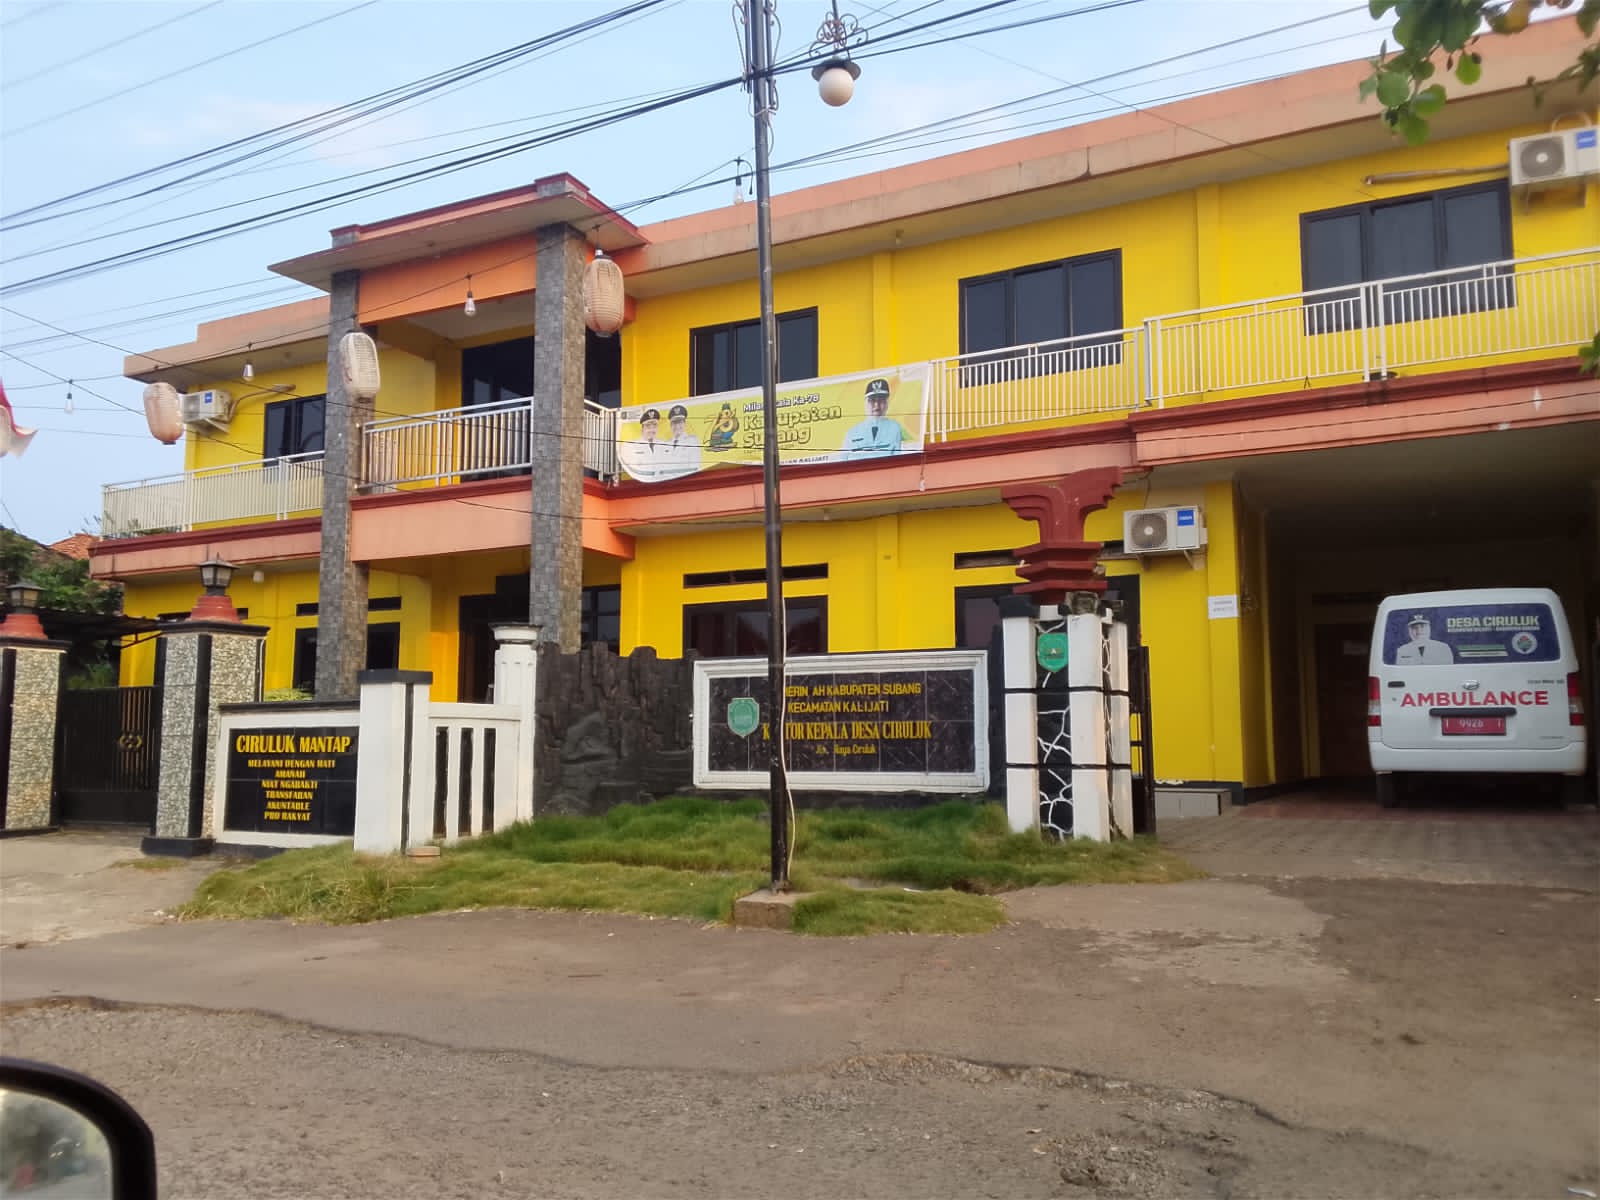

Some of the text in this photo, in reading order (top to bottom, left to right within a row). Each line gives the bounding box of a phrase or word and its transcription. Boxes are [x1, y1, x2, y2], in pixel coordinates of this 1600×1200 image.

[743, 405, 842, 432] Kaupaten
[743, 426, 811, 449] Suang
[1447, 614, 1540, 628] DESA CIRULUK
[826, 683, 880, 696] KABUPATEN
[882, 682, 922, 695] SUBANG
[1400, 690, 1549, 707] AMBULANCE
[787, 701, 889, 713] KECAMATAN KALIJATI
[762, 720, 932, 740] KTOR KEPALA DESA CIRULUK
[236, 735, 351, 753] CIRULUK MANTAP
[247, 759, 284, 768] MELAYANI
[284, 759, 315, 768] DENGAN
[275, 770, 306, 779] AMANAH
[262, 779, 278, 788] NIAT
[281, 811, 312, 821] RAKYAT
